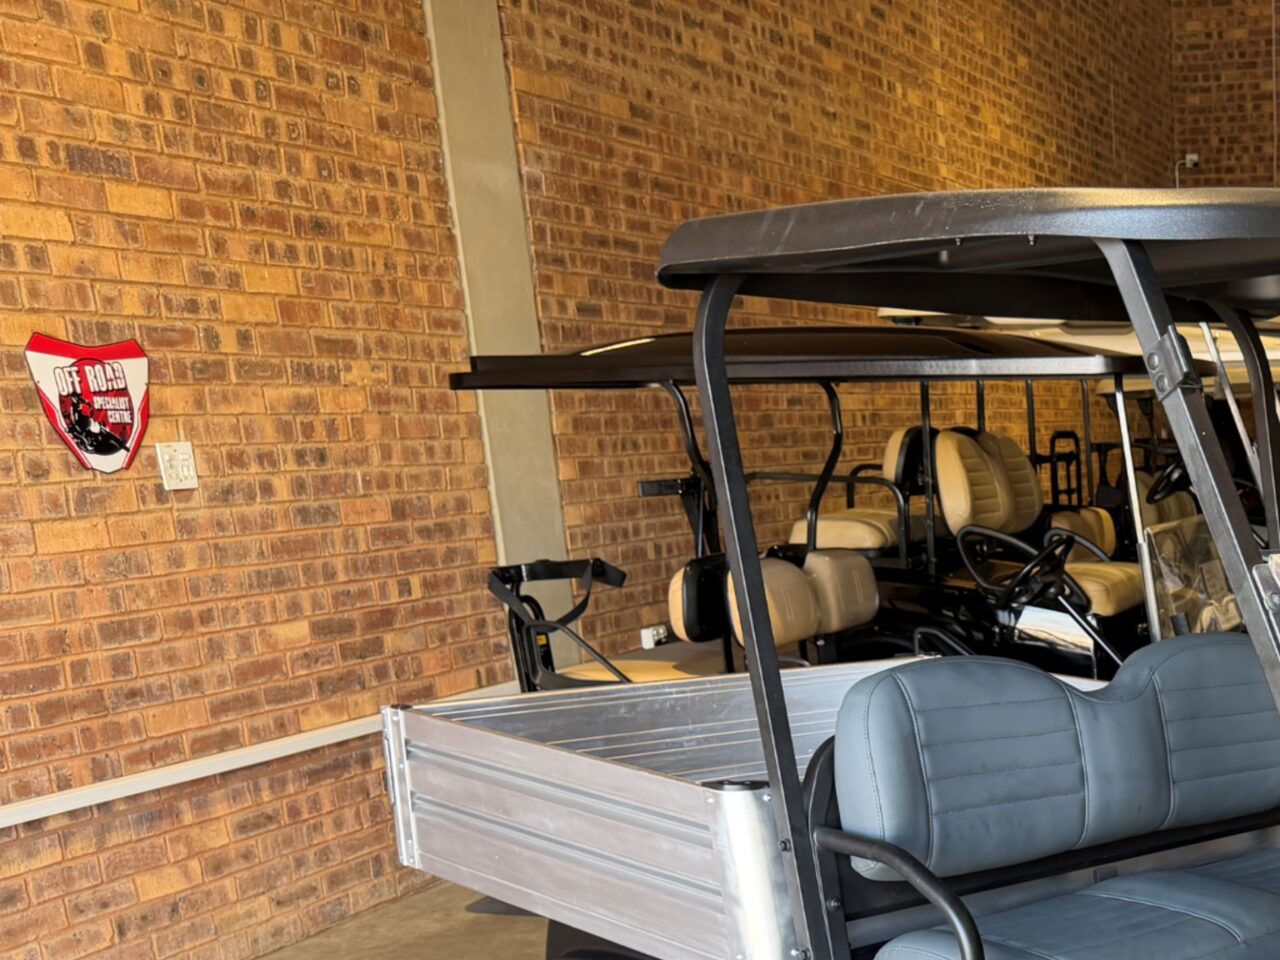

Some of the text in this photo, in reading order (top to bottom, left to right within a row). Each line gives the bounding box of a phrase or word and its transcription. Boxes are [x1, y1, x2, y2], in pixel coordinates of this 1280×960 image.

[54, 361, 126, 396] OFF ROAD
[107, 410, 132, 424] CENTRE
